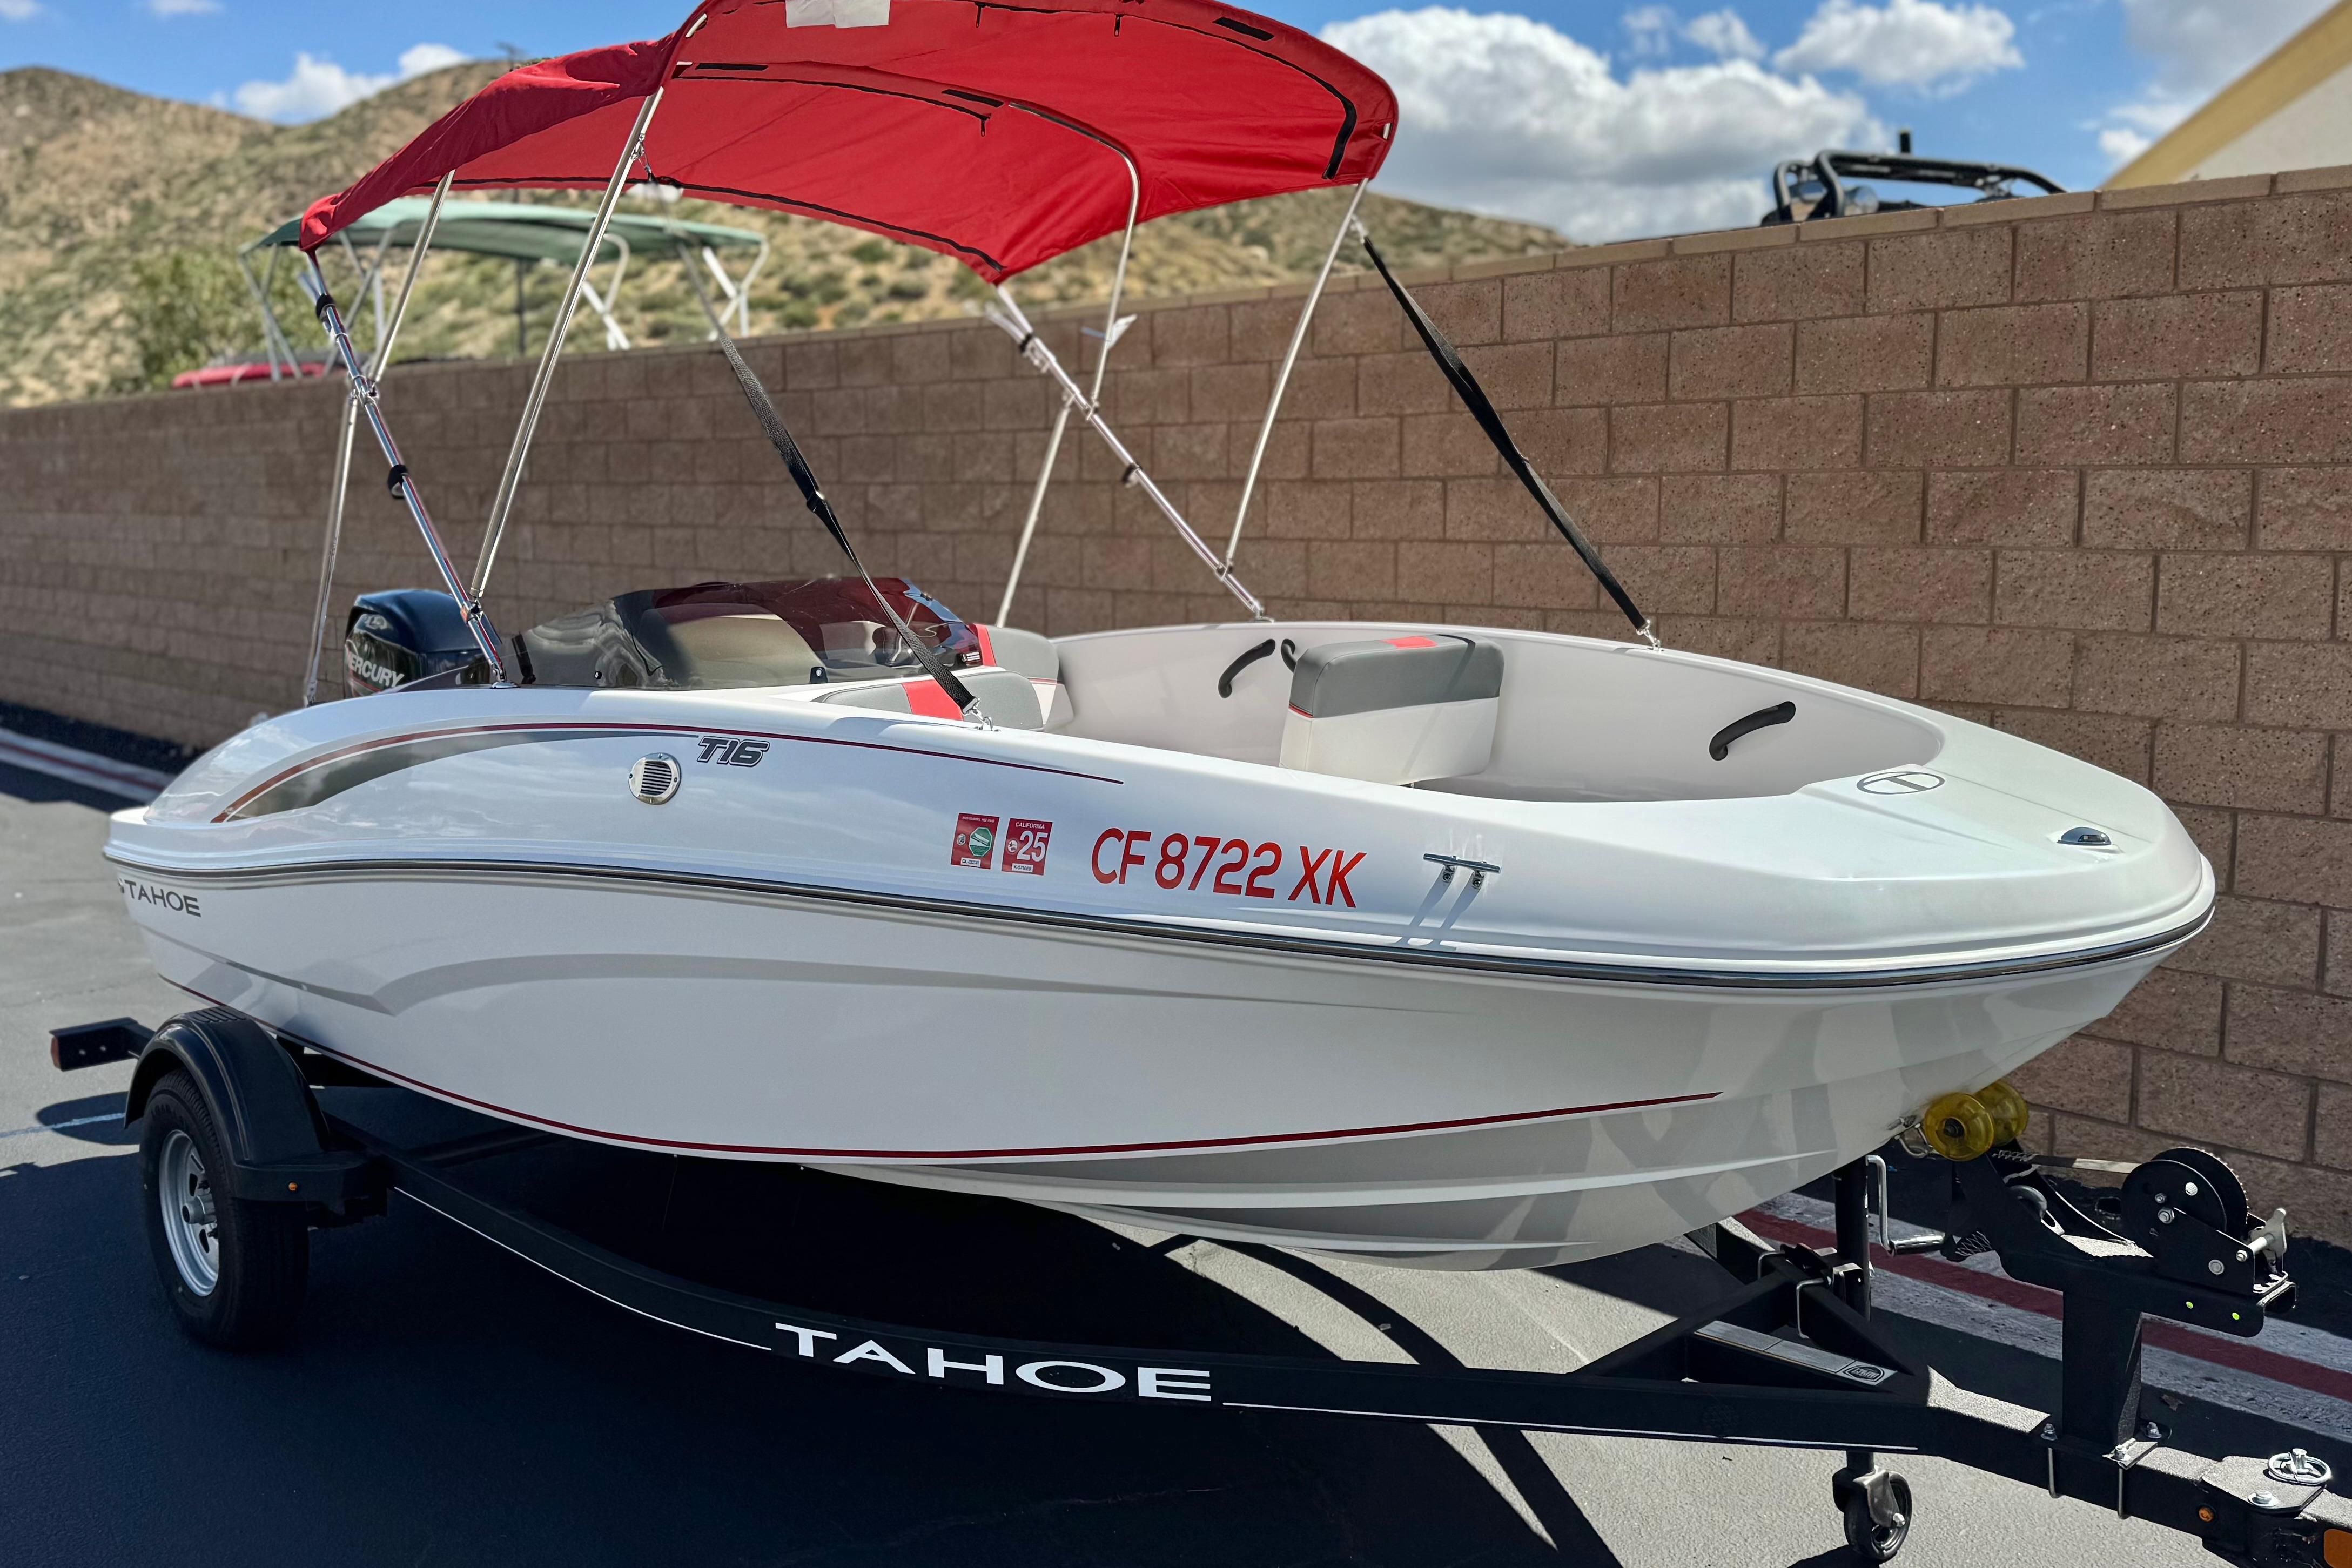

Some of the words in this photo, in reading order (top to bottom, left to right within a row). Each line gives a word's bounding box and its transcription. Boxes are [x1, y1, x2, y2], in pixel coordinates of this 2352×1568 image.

[347, 652, 405, 688] ERCURY
[697, 736, 770, 767] T16
[1015, 822, 1045, 830] CALIFORNIA
[1016, 830, 1049, 862] 25
[1093, 829, 1150, 883] CF
[1157, 834, 1282, 897] 8722
[1290, 846, 1366, 907] XK
[124, 879, 201, 918] TAHOE
[775, 1322, 1211, 1401] TAHOE
